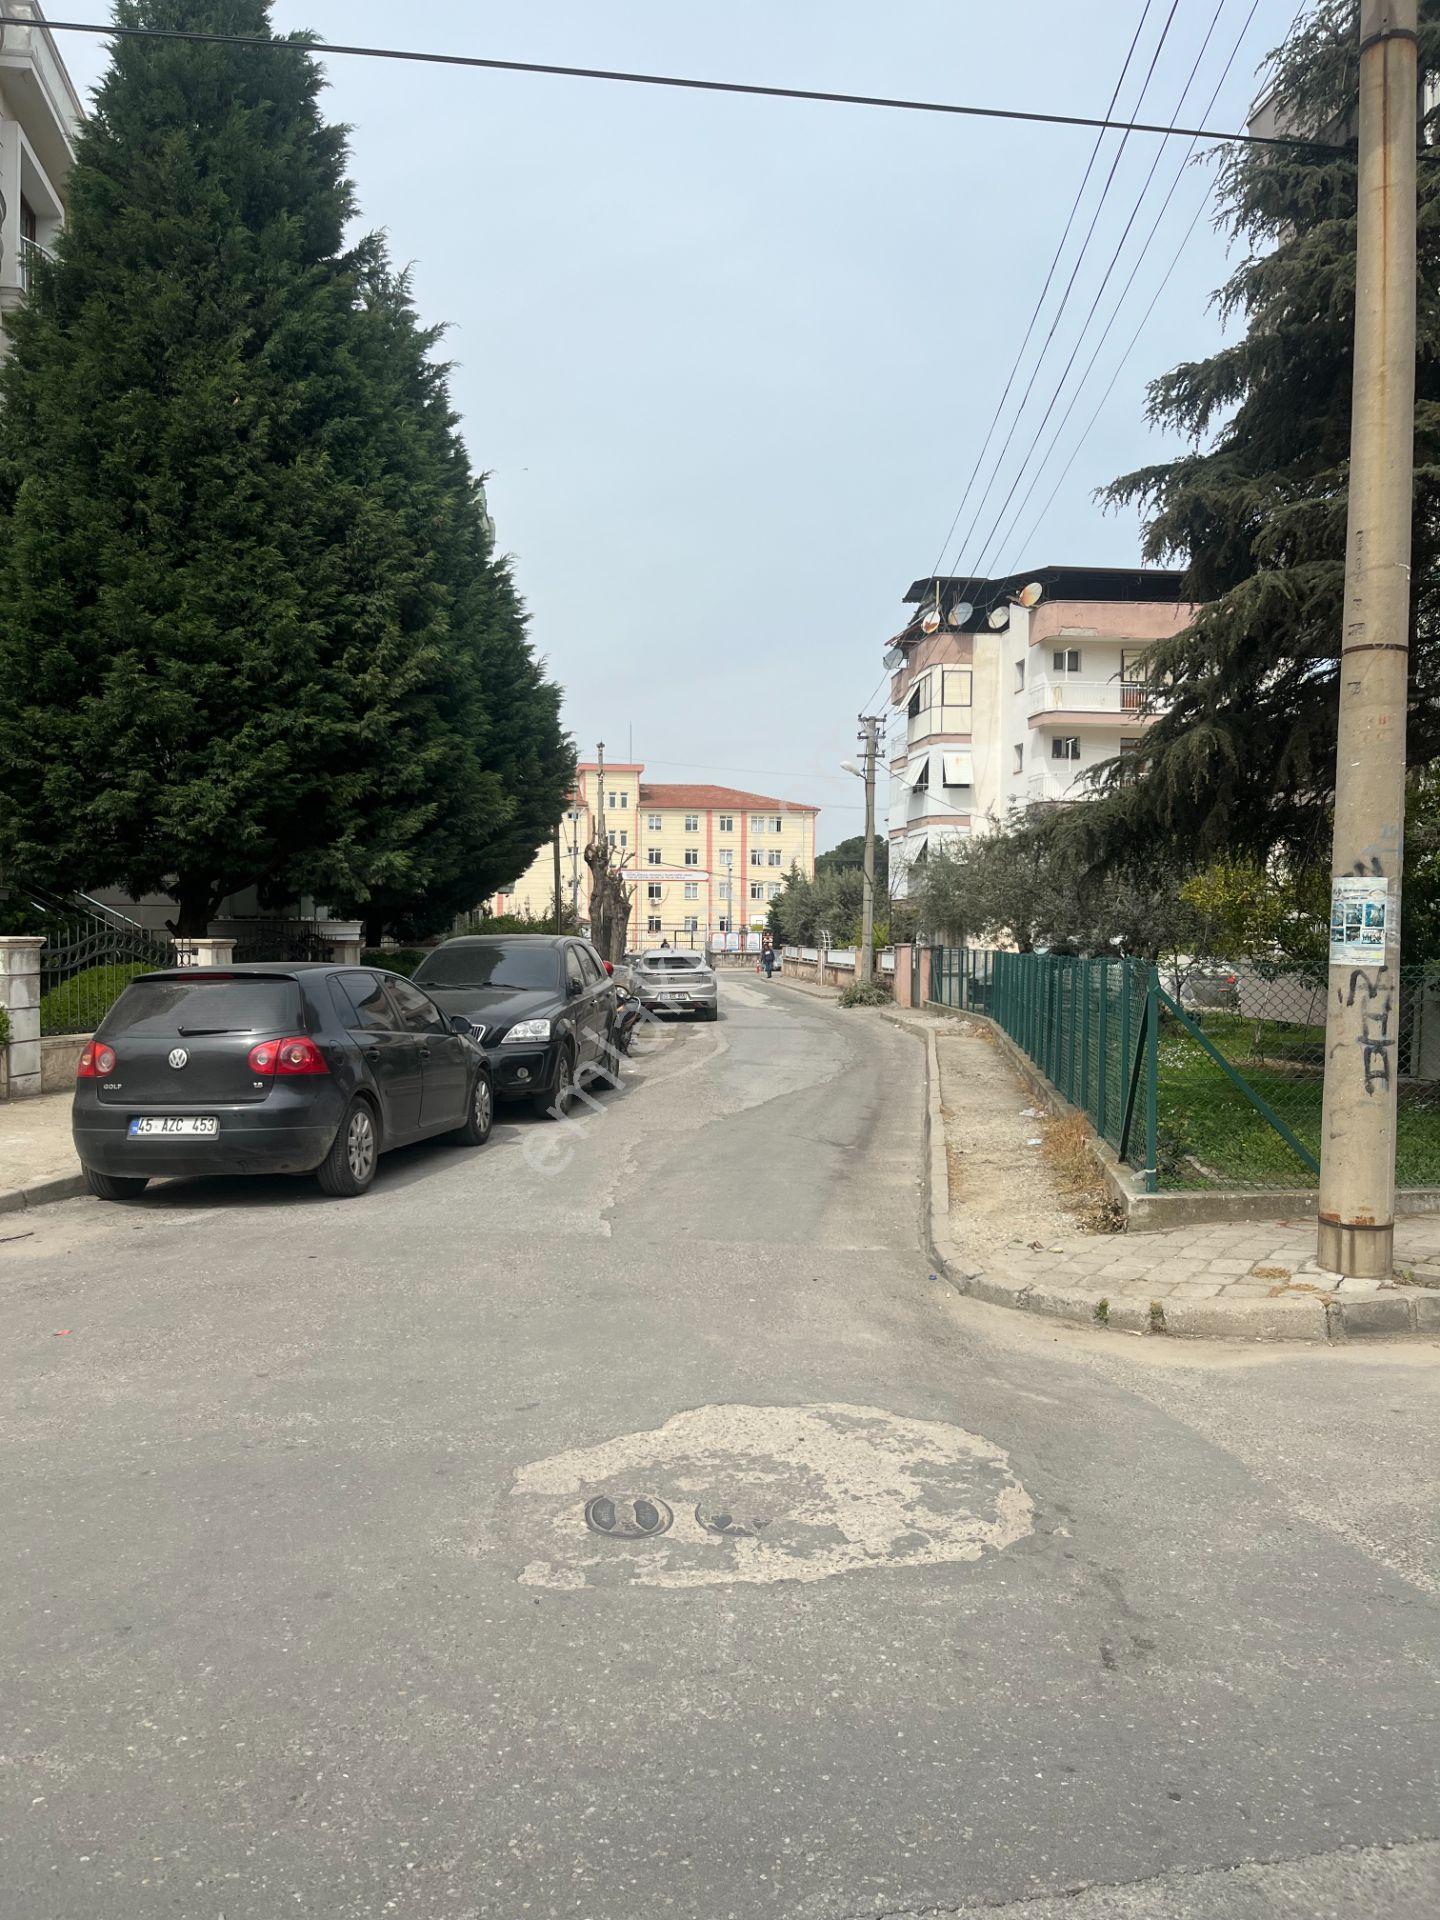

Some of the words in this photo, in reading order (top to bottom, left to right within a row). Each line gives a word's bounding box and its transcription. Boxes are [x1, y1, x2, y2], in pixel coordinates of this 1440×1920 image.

[138, 1118, 153, 1132] 45
[161, 1117, 184, 1132] AZC
[192, 1117, 215, 1132] 453
